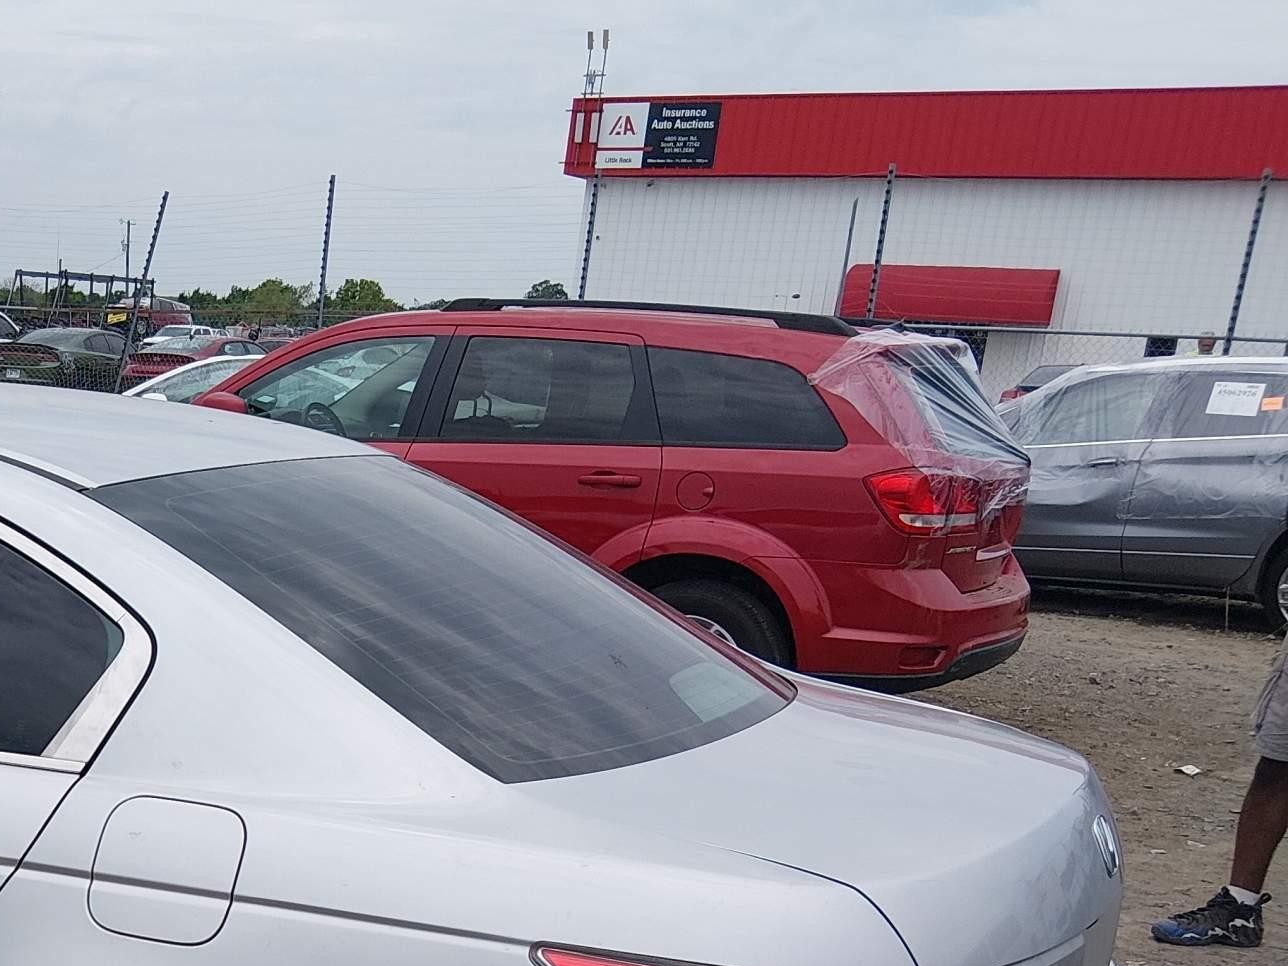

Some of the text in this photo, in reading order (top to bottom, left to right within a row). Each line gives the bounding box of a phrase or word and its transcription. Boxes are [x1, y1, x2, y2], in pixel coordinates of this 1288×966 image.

[662, 107, 707, 118] Insurance
[651, 118, 715, 130] Auto Auctions
